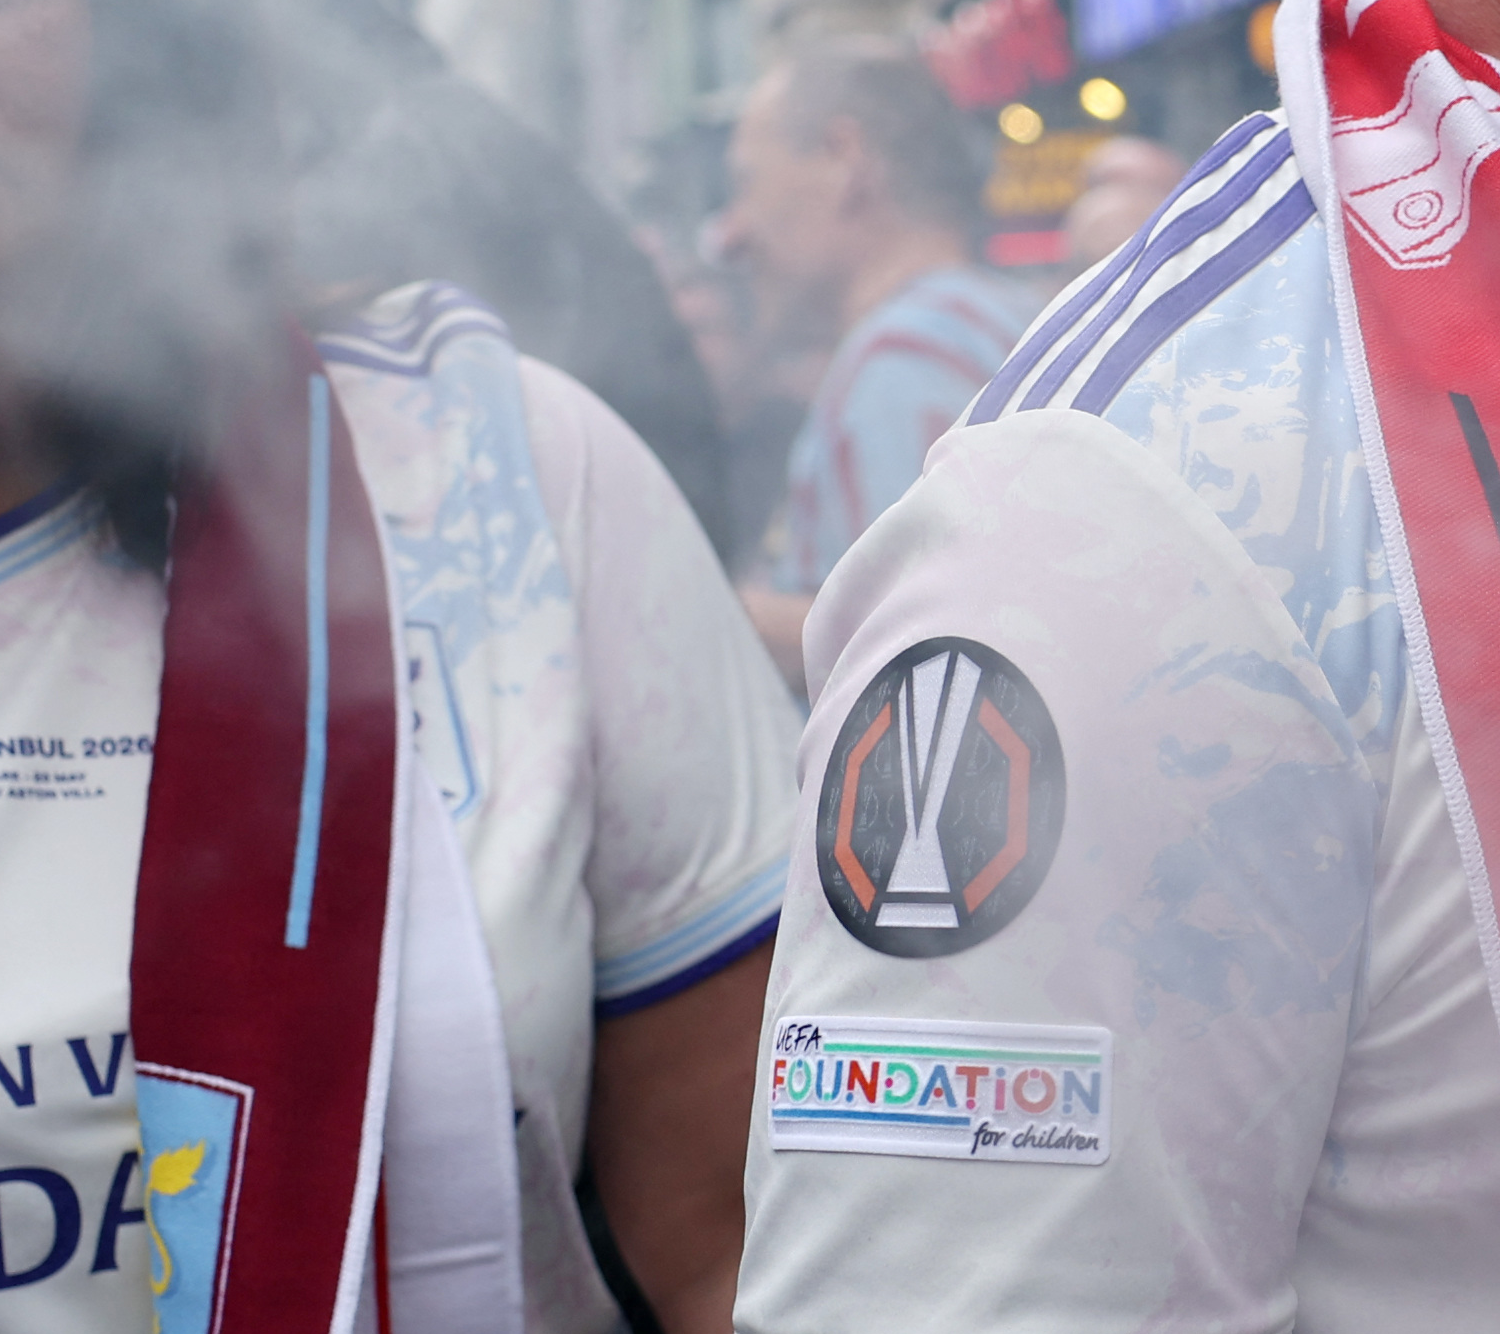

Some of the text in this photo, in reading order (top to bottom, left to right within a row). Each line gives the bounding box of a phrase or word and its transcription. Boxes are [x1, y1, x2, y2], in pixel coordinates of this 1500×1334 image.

[82, 734, 154, 759] 2026
[775, 1022, 823, 1053] UEFA
[772, 1057, 1100, 1116] FOUNDATION
[970, 1122, 1100, 1155] for children
